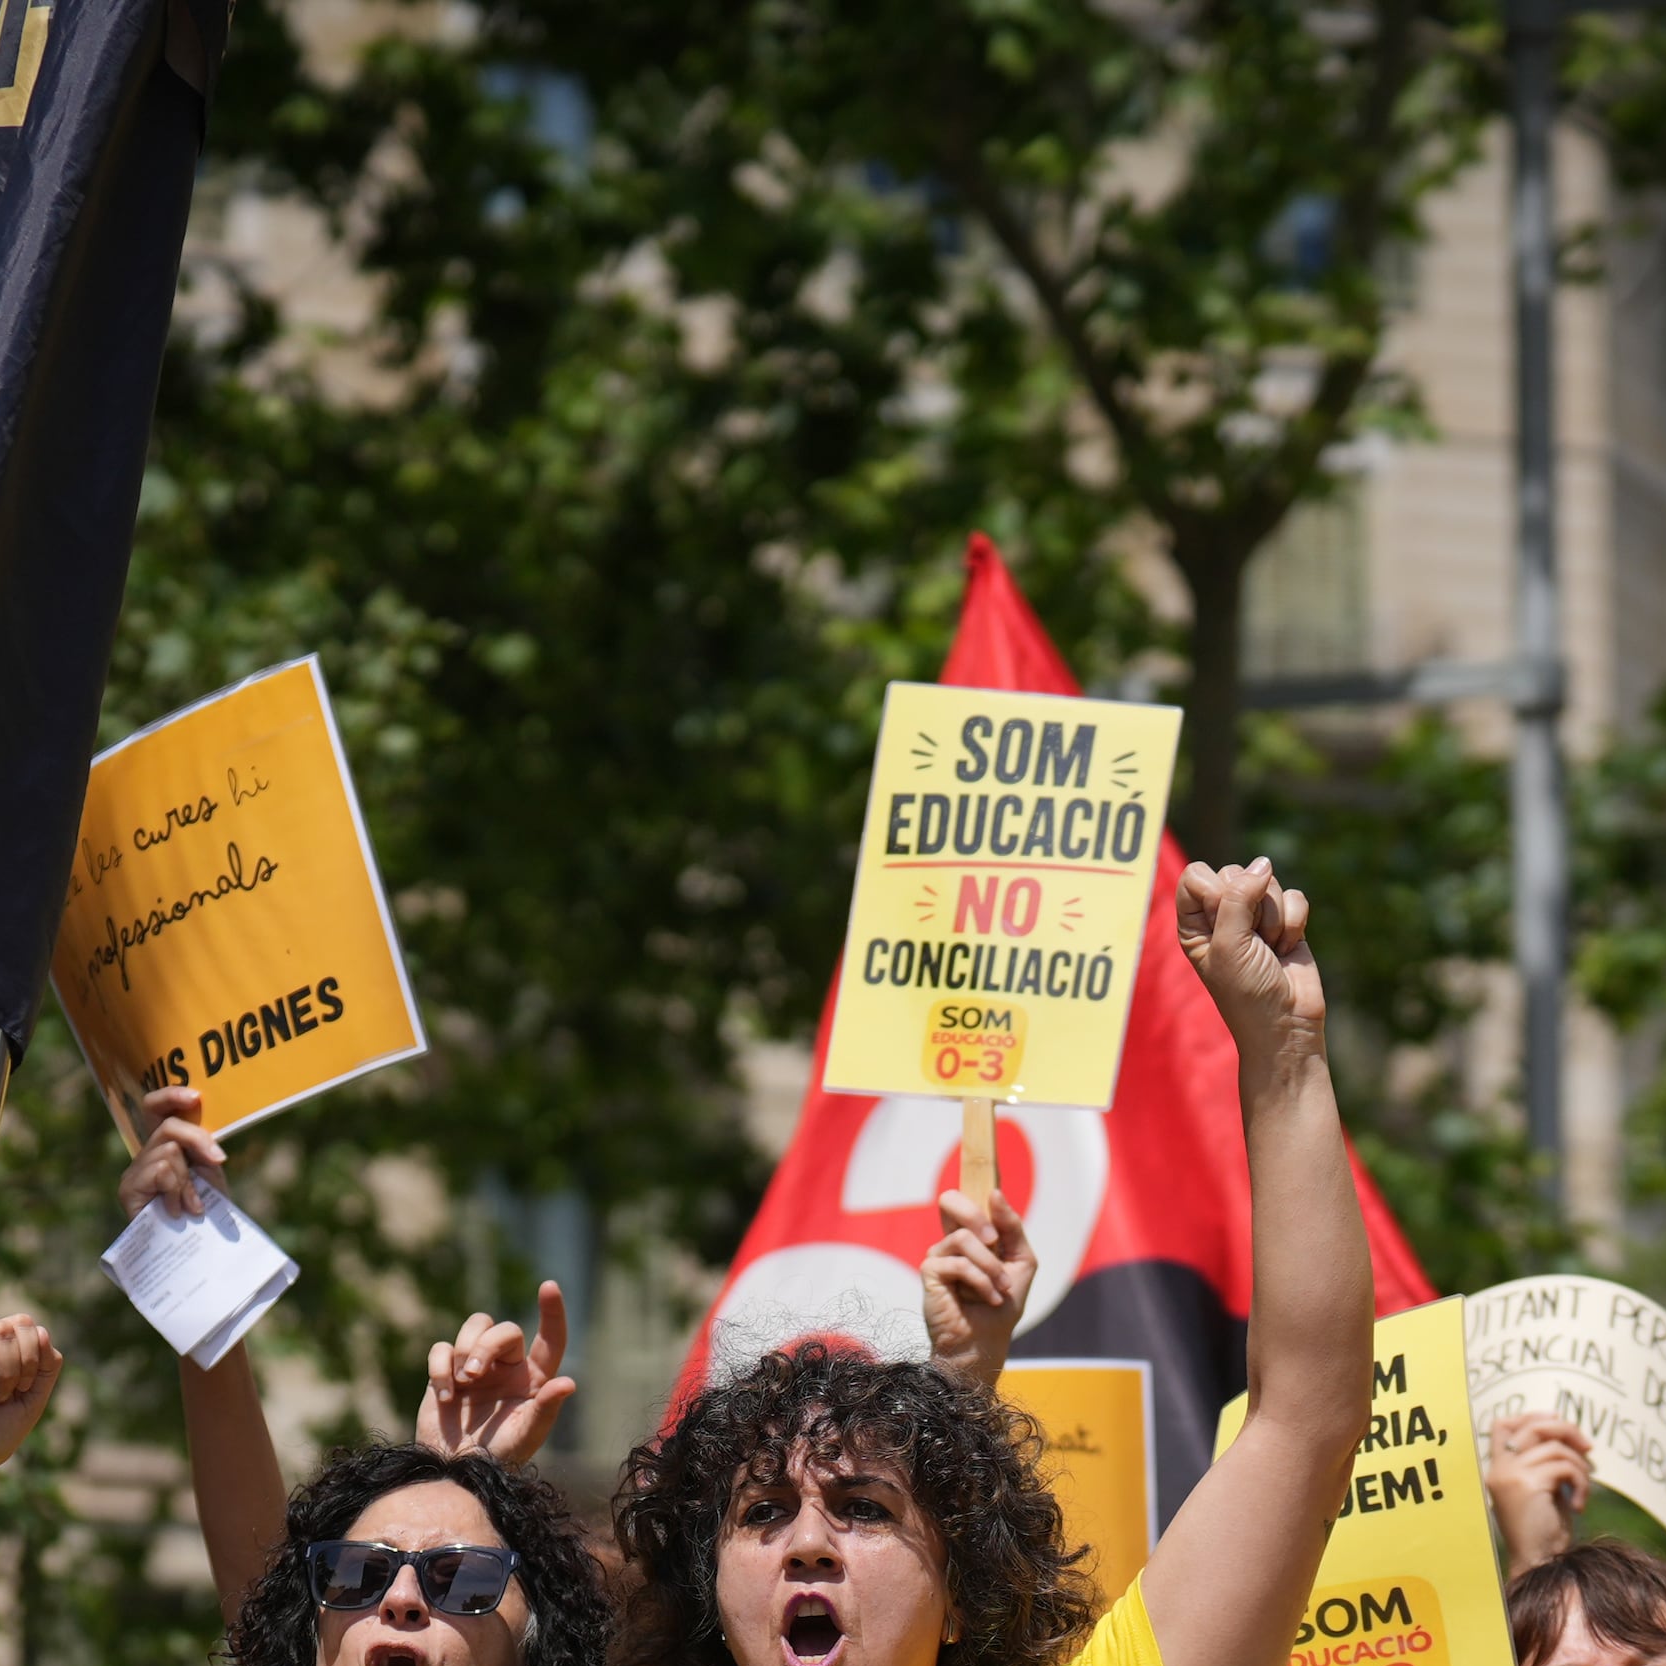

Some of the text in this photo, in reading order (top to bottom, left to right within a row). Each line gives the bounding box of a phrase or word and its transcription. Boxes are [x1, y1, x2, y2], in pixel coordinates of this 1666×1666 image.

[954, 714, 1097, 789] SOM
[133, 795, 218, 855] cures
[226, 765, 271, 808] hi
[884, 790, 1147, 863] EDUCACIÓ
[87, 841, 278, 1016] professionals
[953, 873, 1042, 937] NO
[863, 937, 1113, 1002] CONCILIACIÓ
[199, 976, 345, 1078] DIGNES
[930, 1029, 1017, 1050] EDUCACIÓ
[938, 1004, 1013, 1033] SOM
[934, 1048, 1005, 1082] 0-3
